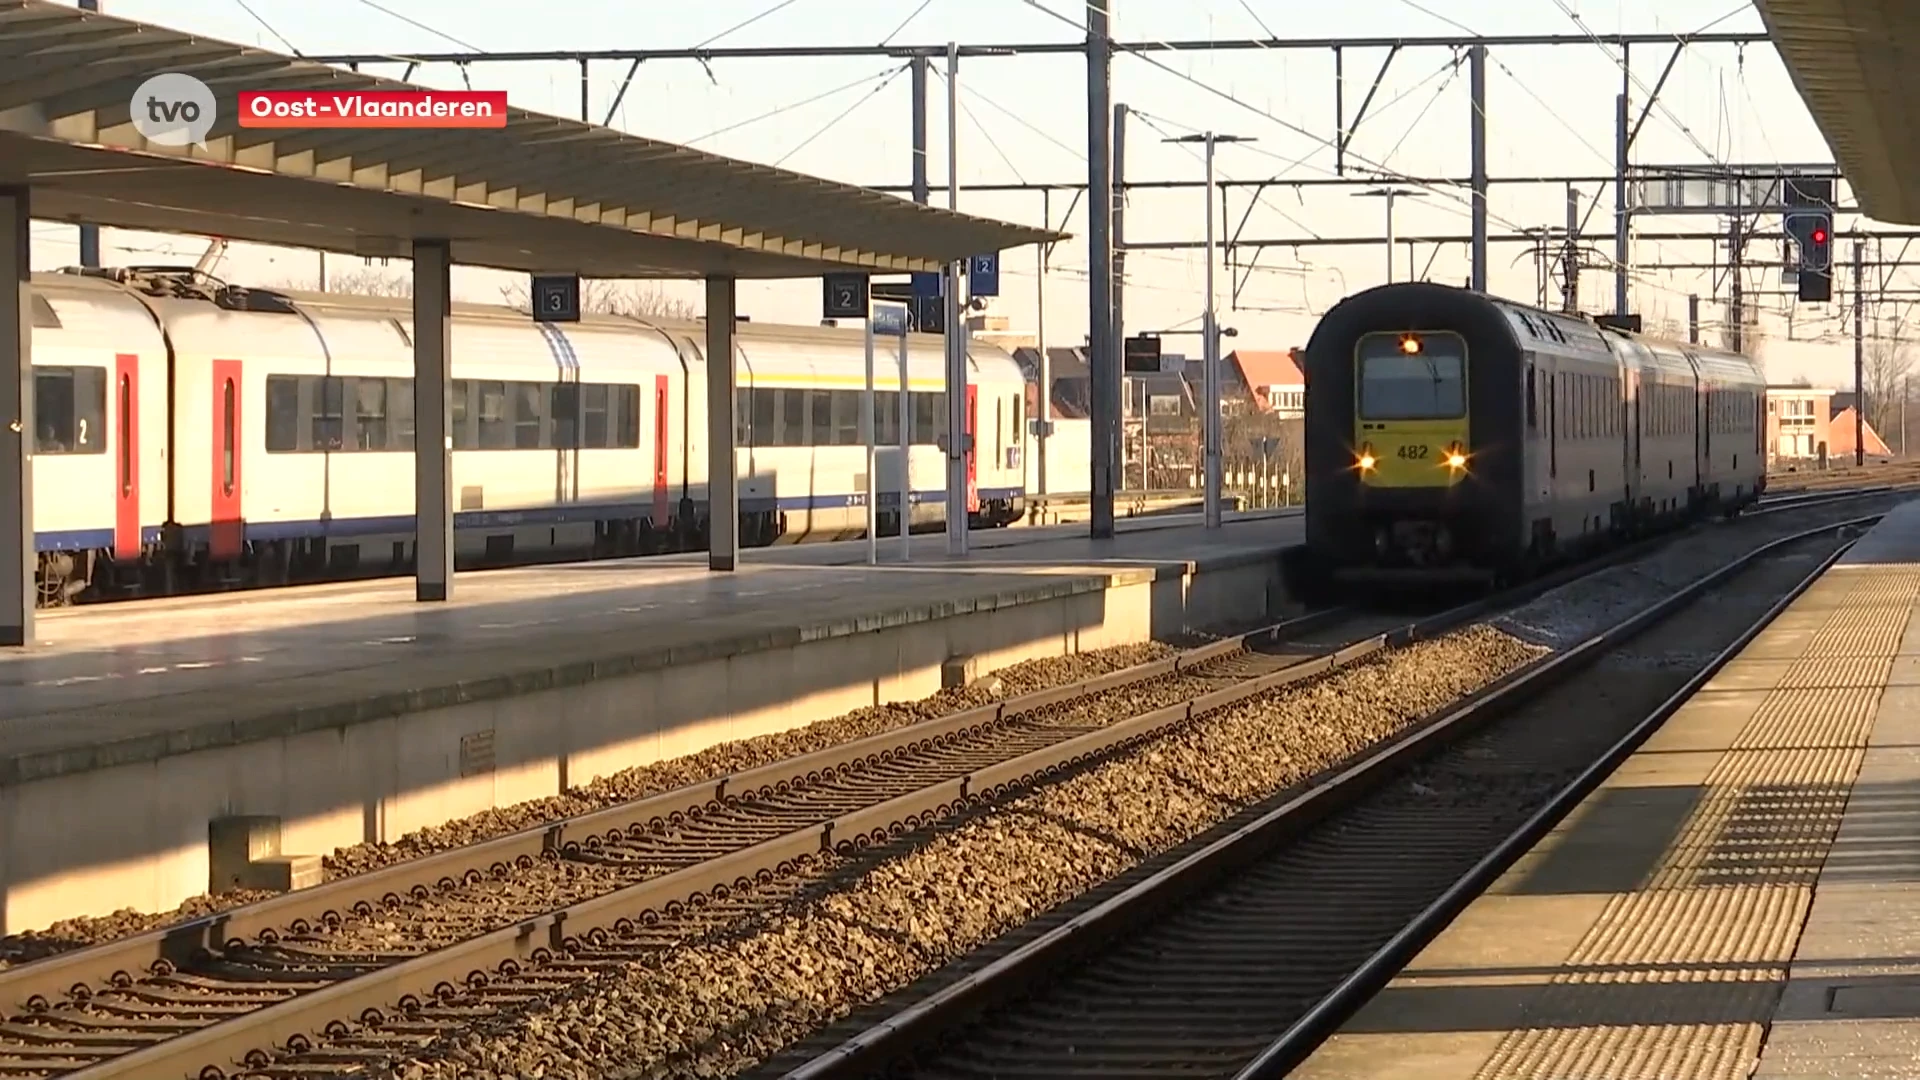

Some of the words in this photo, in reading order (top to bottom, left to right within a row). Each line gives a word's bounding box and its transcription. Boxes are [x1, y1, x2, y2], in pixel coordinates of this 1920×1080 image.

[550, 294, 561, 311] 3
[840, 290, 852, 308] 2
[79, 418, 87, 444] 2
[1397, 444, 1429, 460] 482
